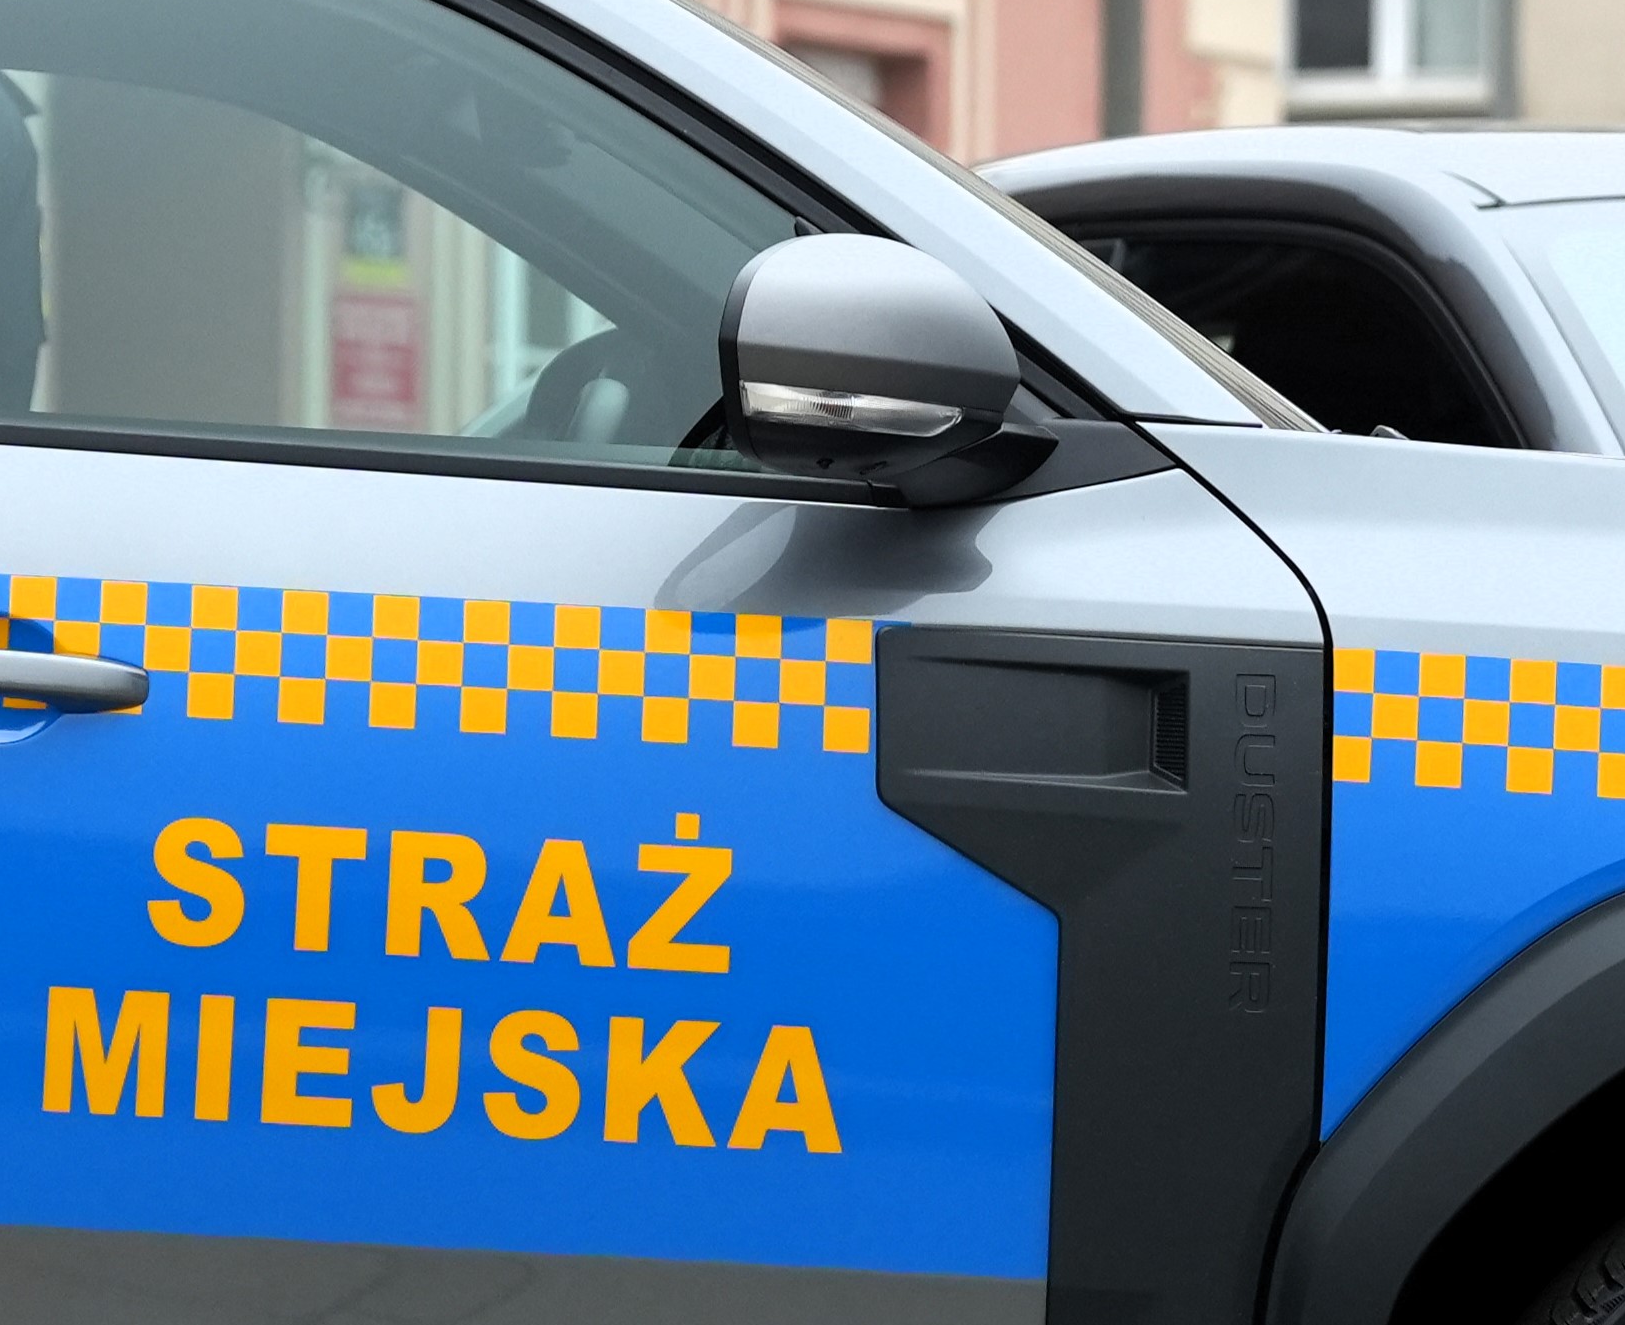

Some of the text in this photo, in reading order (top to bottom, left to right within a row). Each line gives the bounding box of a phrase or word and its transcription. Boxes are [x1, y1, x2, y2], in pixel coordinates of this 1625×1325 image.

[147, 812, 733, 974] STRAŻ
[1228, 673, 1277, 1014] DUSTER
[42, 986, 842, 1154] MIEJSKA
